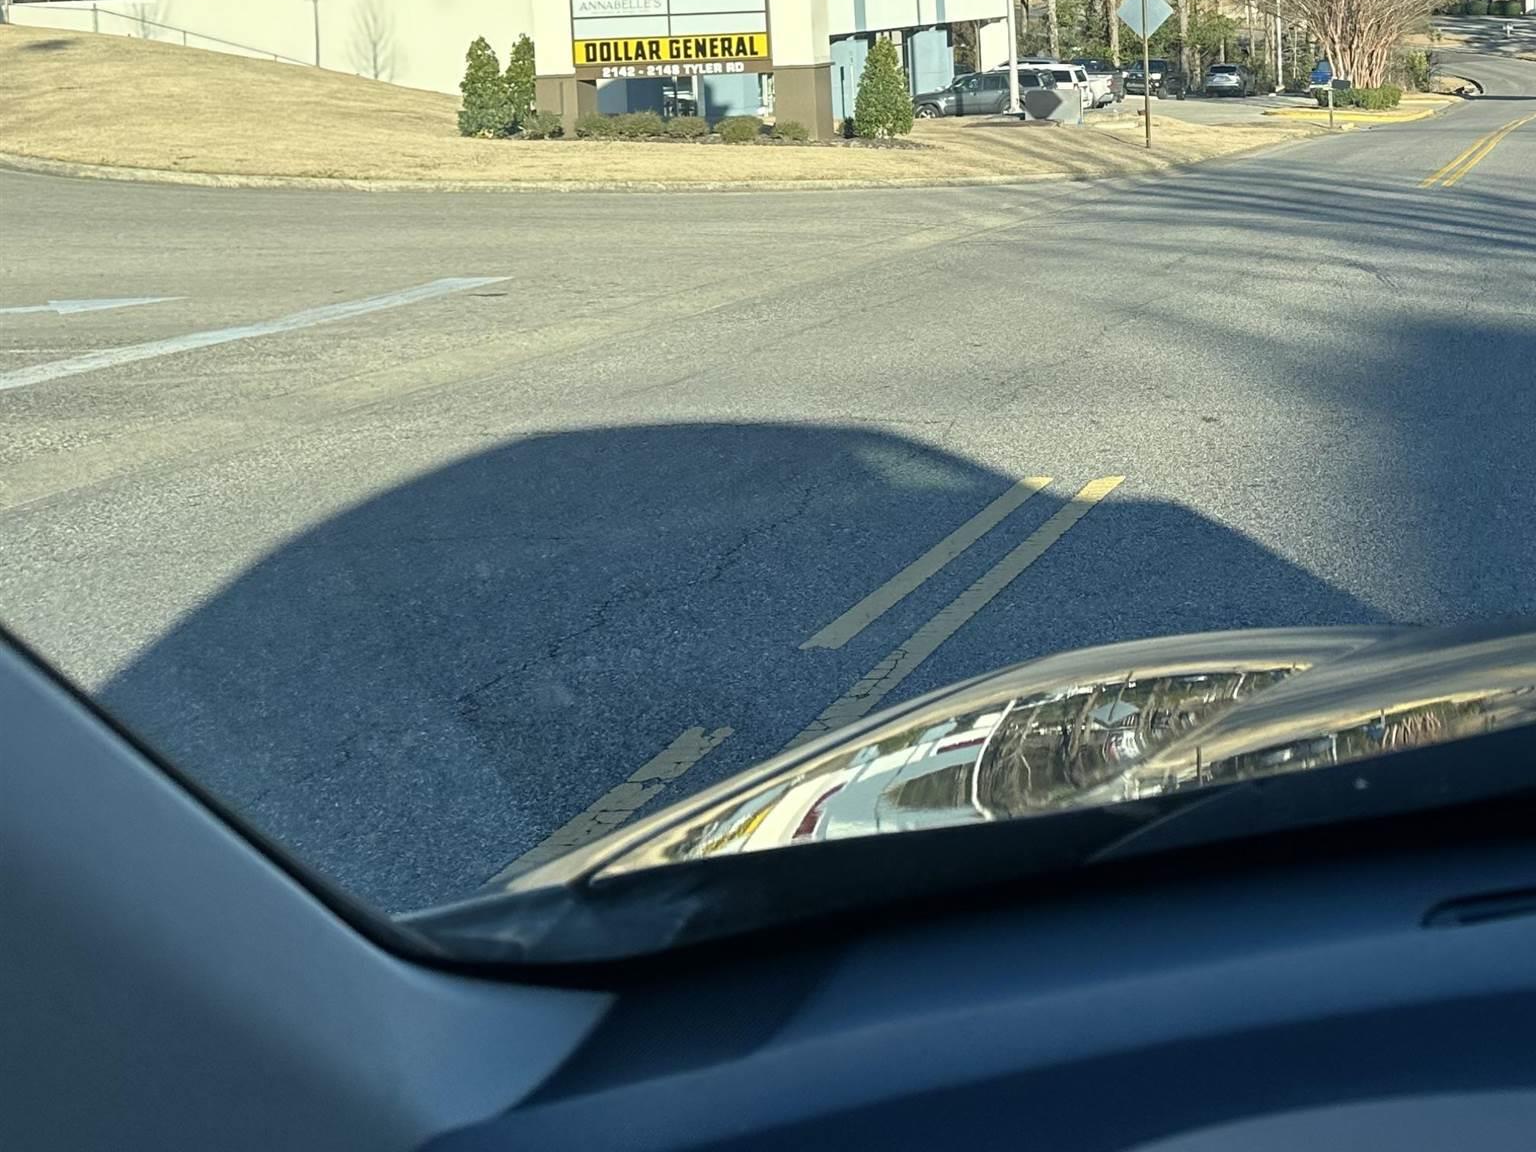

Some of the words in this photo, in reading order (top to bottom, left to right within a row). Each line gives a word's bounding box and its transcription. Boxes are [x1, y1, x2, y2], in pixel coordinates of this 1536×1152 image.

[584, 40, 661, 62] DOLLAR
[669, 36, 758, 59] GENERAL
[602, 67, 635, 78] 2142
[683, 63, 723, 74] TYLER
[726, 62, 744, 72] RD
